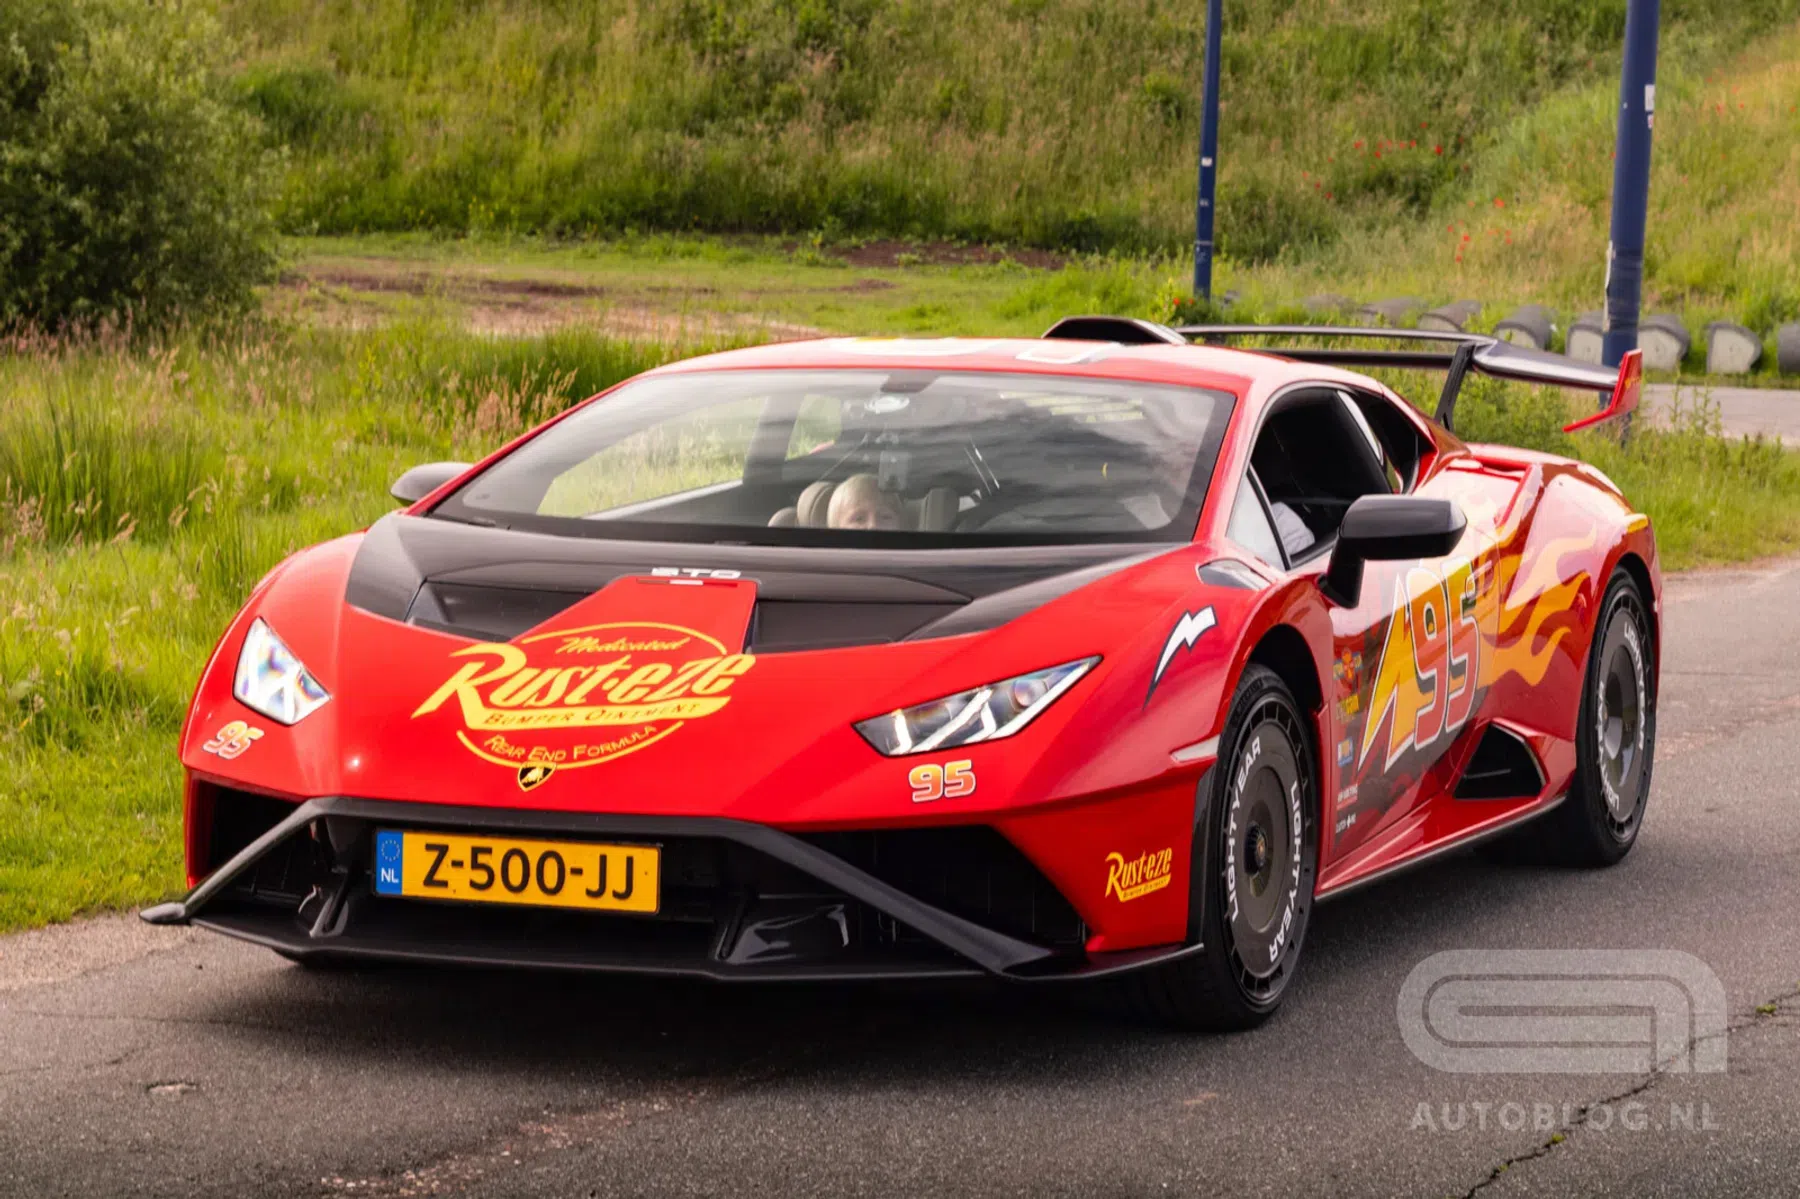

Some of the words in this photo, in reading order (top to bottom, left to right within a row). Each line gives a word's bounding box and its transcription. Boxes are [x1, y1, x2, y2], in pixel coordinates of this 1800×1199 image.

[1405, 555, 1481, 751] 95
[202, 720, 265, 760] 95
[484, 711, 575, 726] BUMPER
[484, 734, 526, 760] REAR
[527, 745, 567, 763] END
[573, 725, 658, 760] FORMULA
[908, 759, 977, 803] 95
[1227, 735, 1262, 923] LIGHTYEAR
[381, 867, 399, 884] NL
[422, 842, 635, 901] Z-500-JJ
[1268, 780, 1303, 963] LIGHTYEAR
